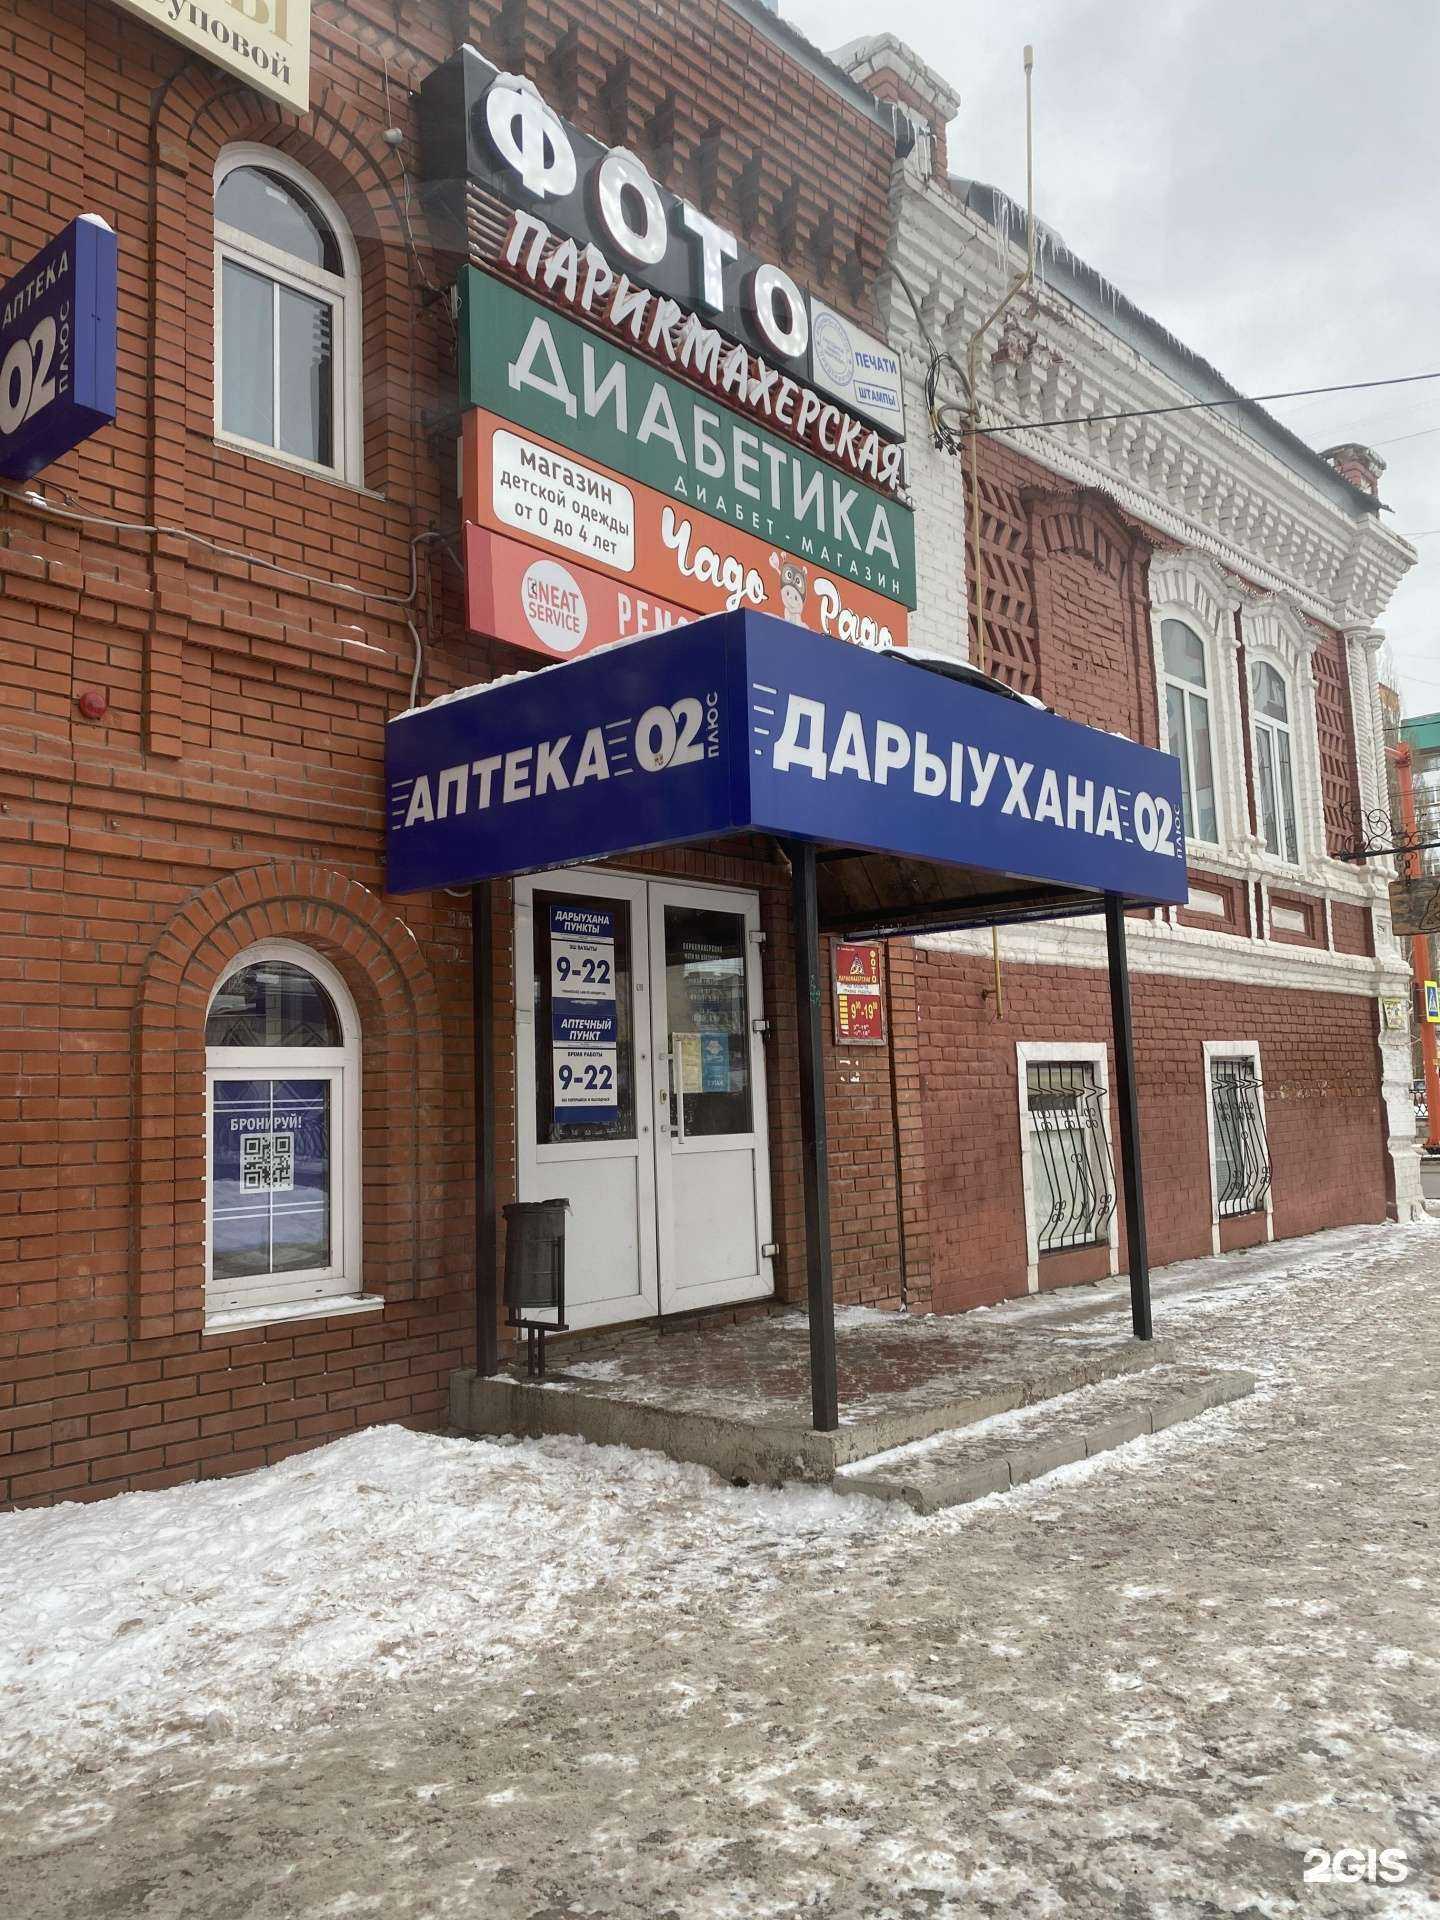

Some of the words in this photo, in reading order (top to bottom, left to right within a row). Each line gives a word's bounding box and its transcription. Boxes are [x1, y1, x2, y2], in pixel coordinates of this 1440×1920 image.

[486, 84, 809, 358] ФОТО
[2, 249, 69, 330] АПТЕКА
[58, 300, 70, 395] ПЛЮС
[505, 208, 902, 490] ПАРИКМАХЕРСКАЯ
[855, 352, 897, 375] ПЕЧАТИ
[858, 387, 896, 406] ШТАМПЫ
[508, 315, 901, 570] ДИАБЕТИКА
[500, 470, 566, 509] детской
[572, 500, 629, 536] одежды
[520, 447, 613, 505] магазин
[515, 503, 533, 520] от
[538, 507, 548, 527] 0
[553, 518, 573, 537] до
[578, 524, 588, 543] 4
[592, 535, 617, 555] лет
[660, 504, 769, 612] Чадо
[528, 602, 581, 634] SERVICE
[538, 580, 579, 614] NEAT
[707, 690, 720, 758] ПЛЮС
[404, 726, 611, 828] АПТЕКА
[773, 693, 1123, 841] ДАРЫУХАНА
[1174, 803, 1183, 860] ПЛЮС
[555, 911, 610, 925] ДАРЫУХАНА
[564, 922, 600, 934] ПУНКТЫ
[556, 956, 611, 985] 9-22
[561, 1018, 612, 1030] АПТЕЧНЫЙ
[569, 1030, 601, 1041] ПУНКТ
[558, 1064, 613, 1090] 9-22
[230, 1113, 302, 1131] БРОНИРУЙ!
